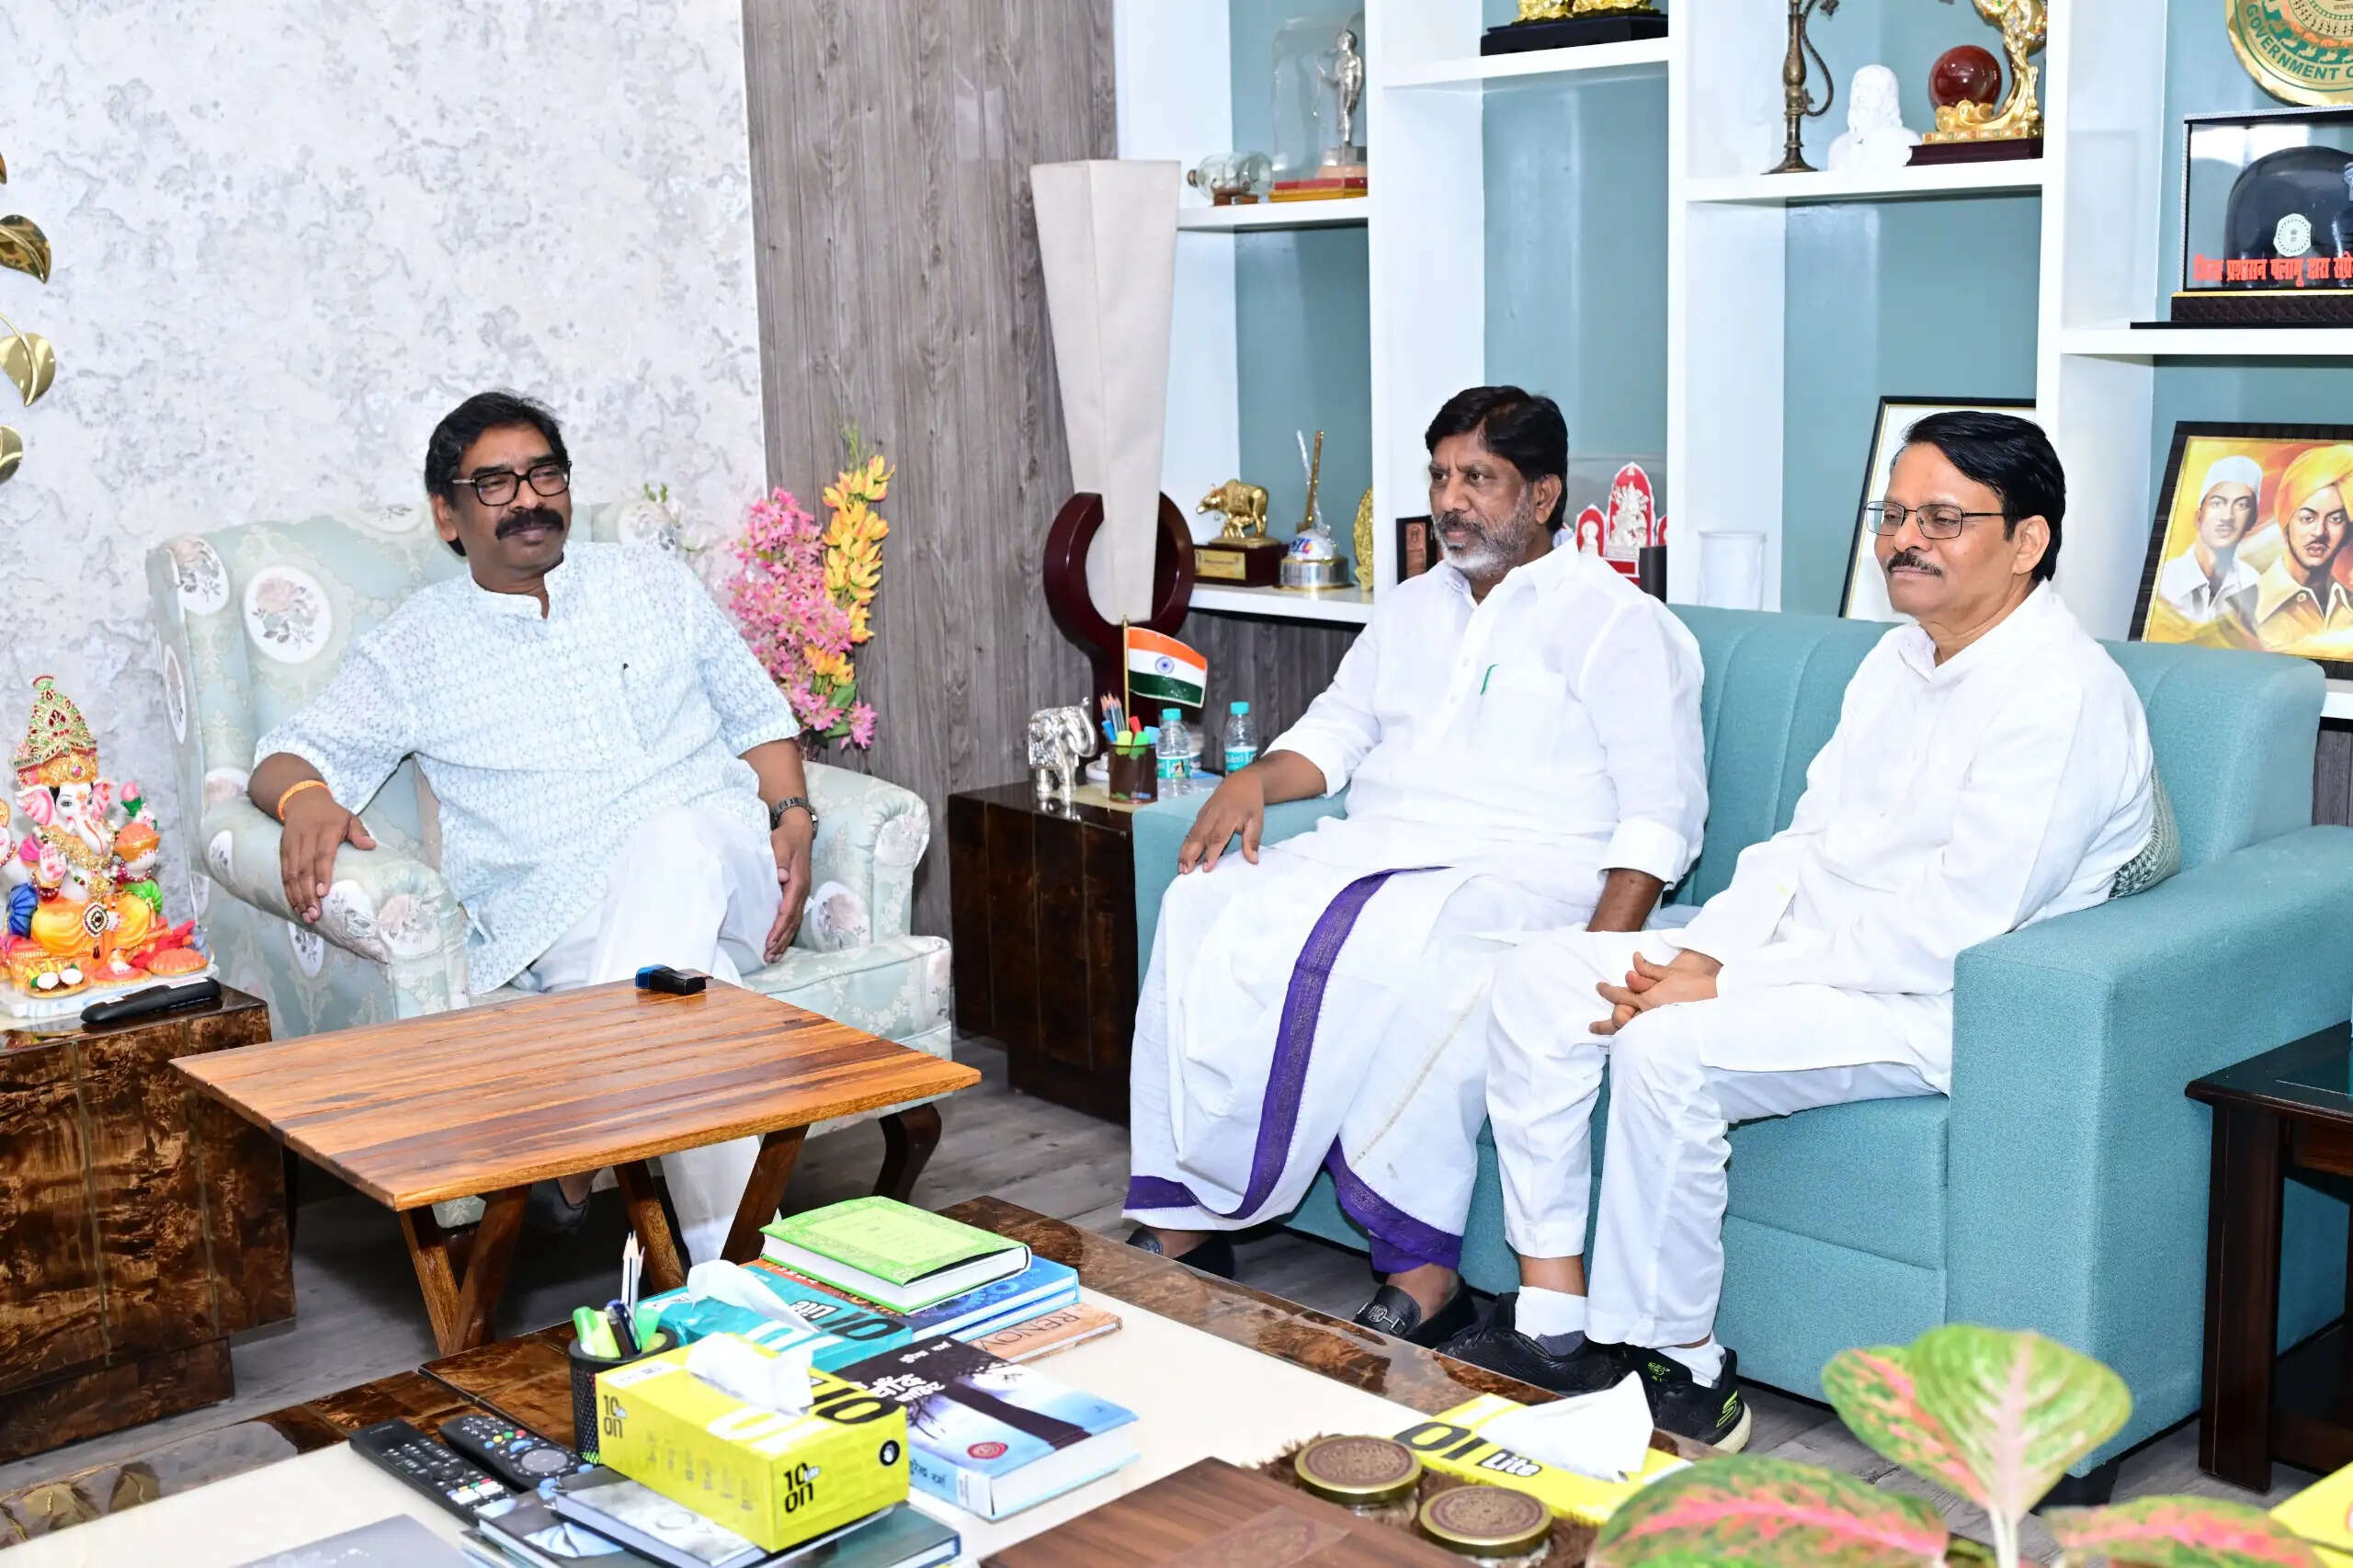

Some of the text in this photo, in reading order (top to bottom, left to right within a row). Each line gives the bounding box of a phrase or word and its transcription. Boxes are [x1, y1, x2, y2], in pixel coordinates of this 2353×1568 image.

[2245, 4, 2340, 81] GOVERNMENT
[783, 1462, 810, 1492] 10
[1475, 1449, 1542, 1477] Lite
